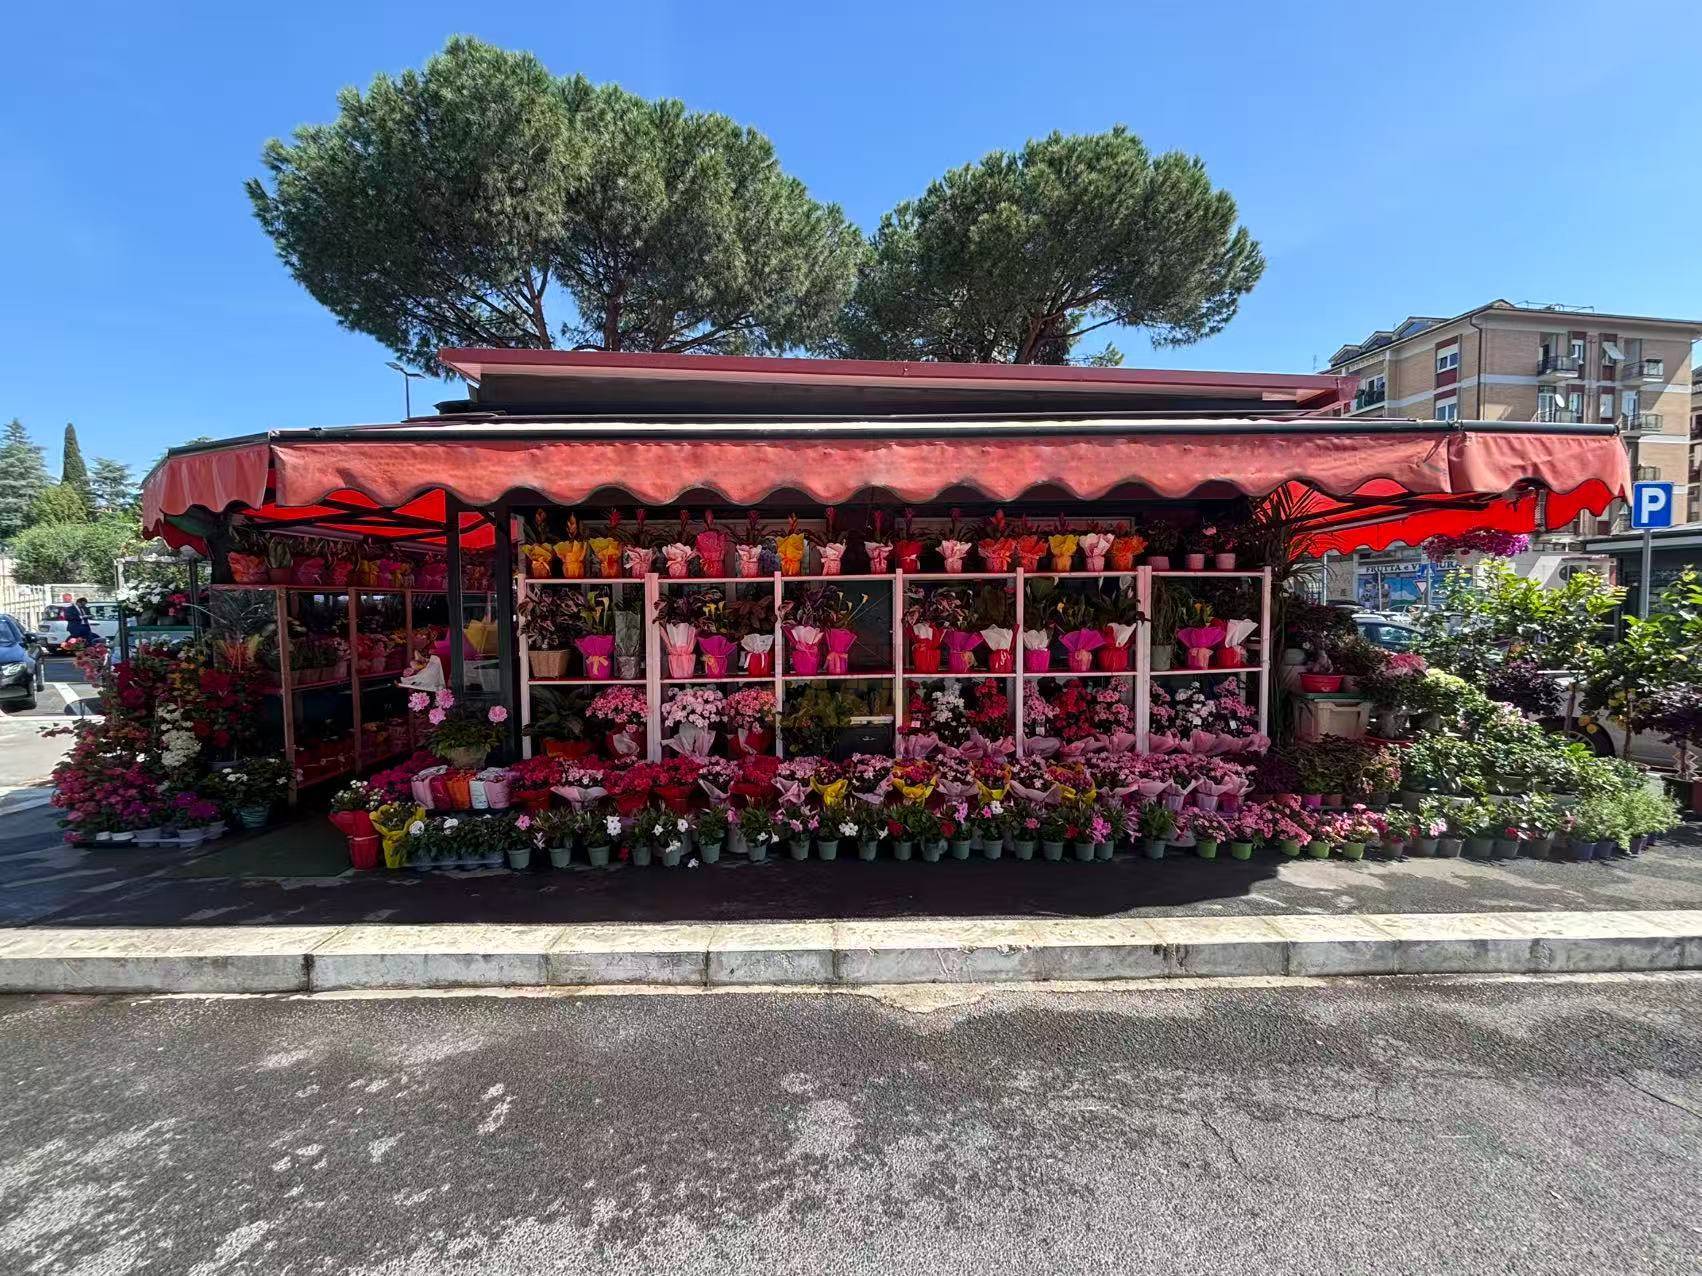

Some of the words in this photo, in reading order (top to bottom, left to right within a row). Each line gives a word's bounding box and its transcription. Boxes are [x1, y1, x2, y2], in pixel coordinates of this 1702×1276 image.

[1641, 487, 1666, 524] P
[1366, 564, 1401, 573] FRUTTA
[1411, 560, 1461, 570] VURA
